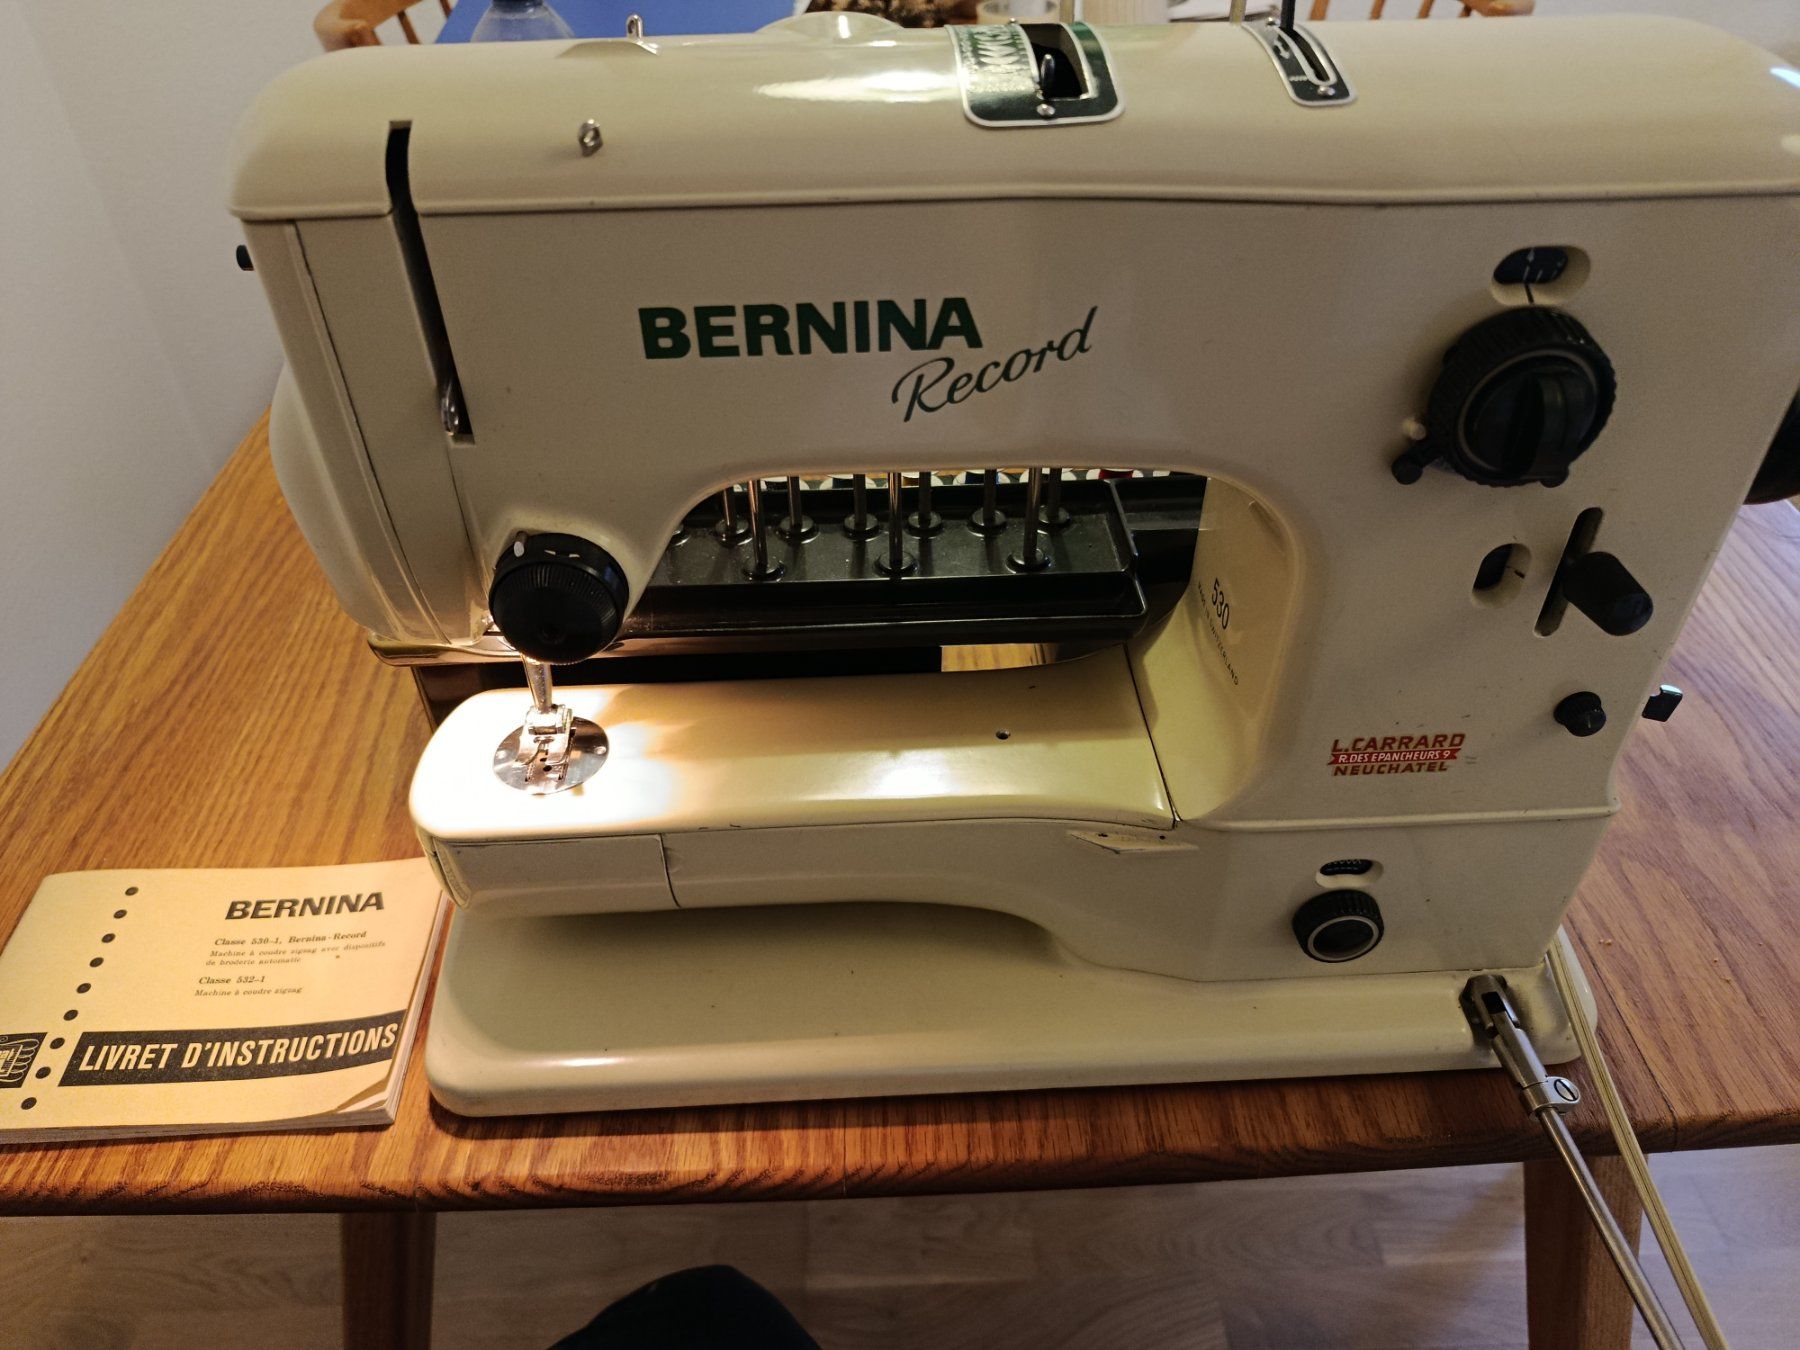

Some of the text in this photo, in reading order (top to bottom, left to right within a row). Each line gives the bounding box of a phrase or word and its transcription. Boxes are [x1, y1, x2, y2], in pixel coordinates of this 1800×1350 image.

[638, 297, 984, 359] BERNINA
[890, 306, 1098, 423] Record
[1211, 578, 1230, 630] 530
[1371, 750, 1440, 762] EPANCHEURS
[1443, 750, 1451, 759] 9
[1333, 761, 1449, 776] NEUCHATEL
[225, 891, 385, 920] BERNINA
[214, 938, 246, 946] Classe
[290, 947, 317, 955] zigzag
[219, 958, 255, 966] broderie
[198, 976, 231, 984] Classe
[194, 989, 232, 997] Machine
[78, 1022, 399, 1071] LIVRET D'INSTRUCTIONS
